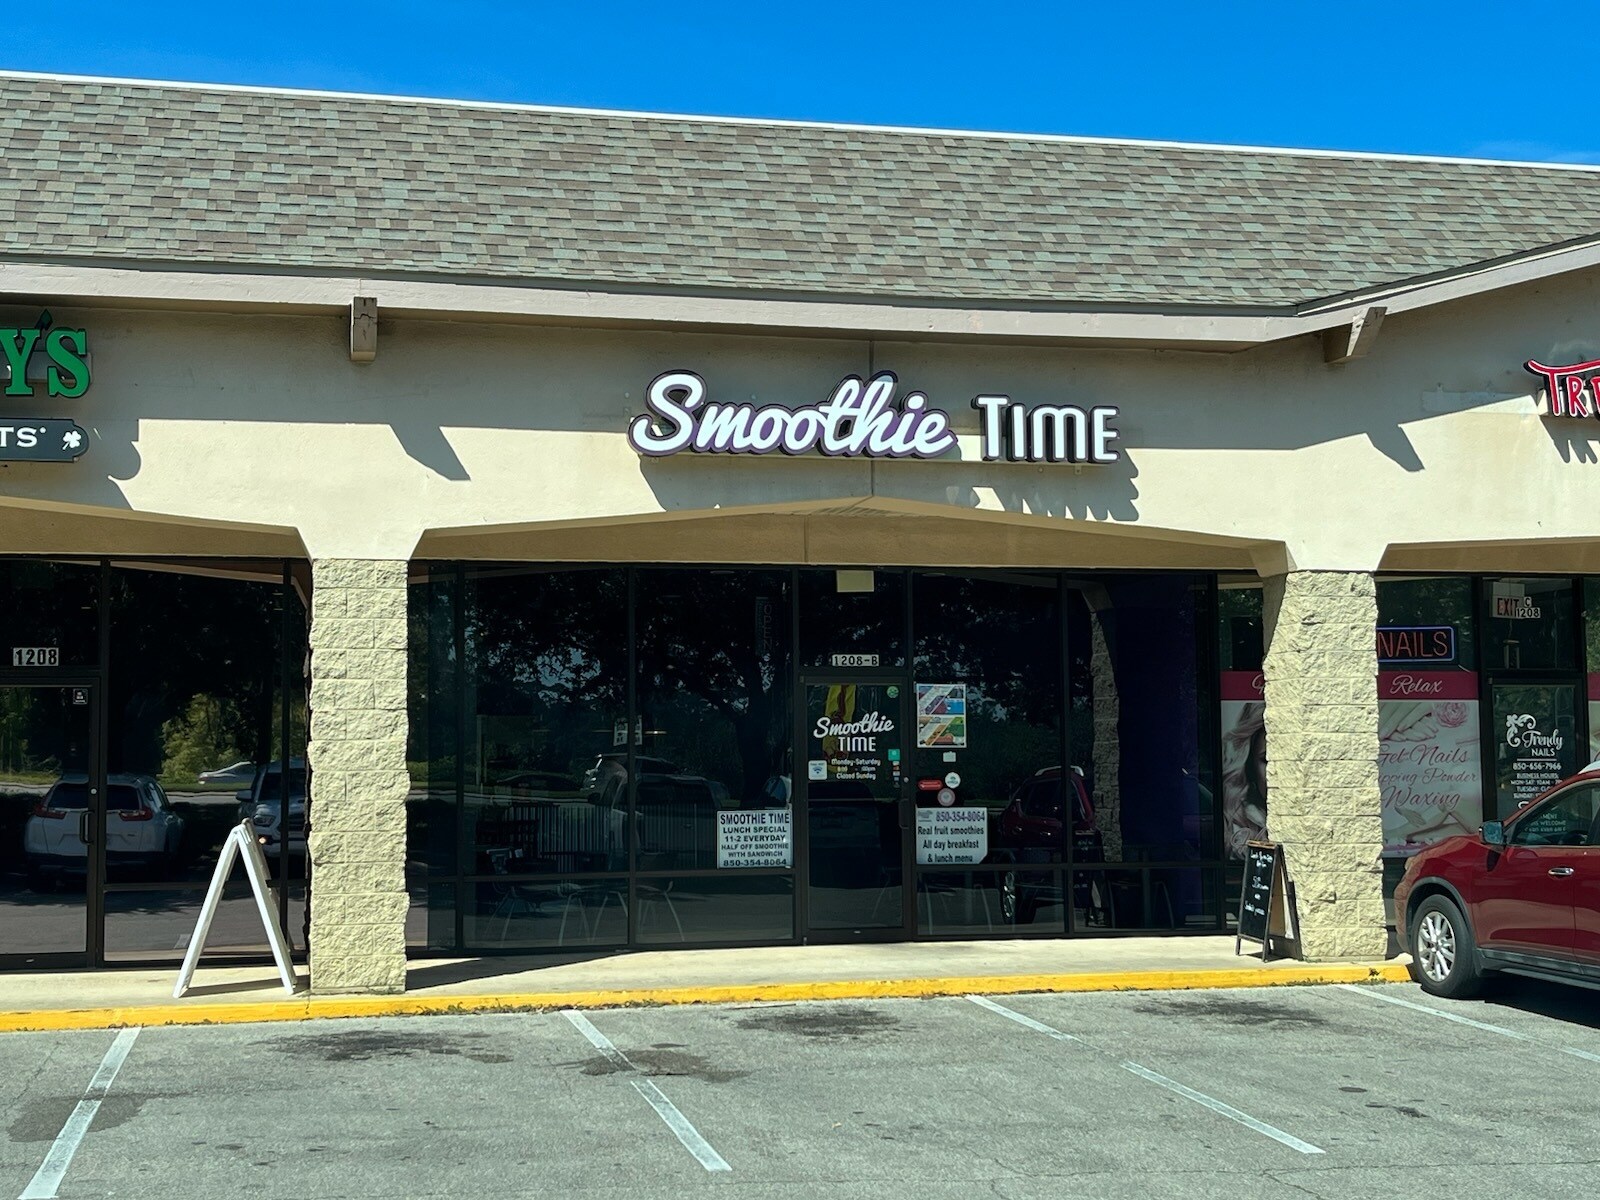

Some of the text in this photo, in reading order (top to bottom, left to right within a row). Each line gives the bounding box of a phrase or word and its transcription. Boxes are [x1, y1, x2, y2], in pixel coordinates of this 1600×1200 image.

[629, 370, 957, 457] Smoothie
[1516, 607, 1540, 618] 1208
[1377, 631, 1448, 657] NAILS
[14, 649, 58, 666] 1208
[833, 655, 878, 666] 1208-B
[1390, 674, 1443, 694] Relax
[813, 711, 894, 738] Smoothie
[838, 736, 876, 752] TIME
[1522, 729, 1563, 750] Trendy
[1409, 743, 1468, 766] Nails
[1531, 748, 1555, 757] NAILS
[1422, 767, 1477, 784] Powder
[1380, 786, 1460, 810] Waxing
[720, 813, 790, 825] SMOOTHIE TIME
[936, 811, 985, 822] 850-354-8064
[918, 826, 984, 835] Real fruit smoothies
[923, 840, 979, 850] All day breakfast
[927, 854, 933, 863] &
[935, 854, 953, 863] lunch
